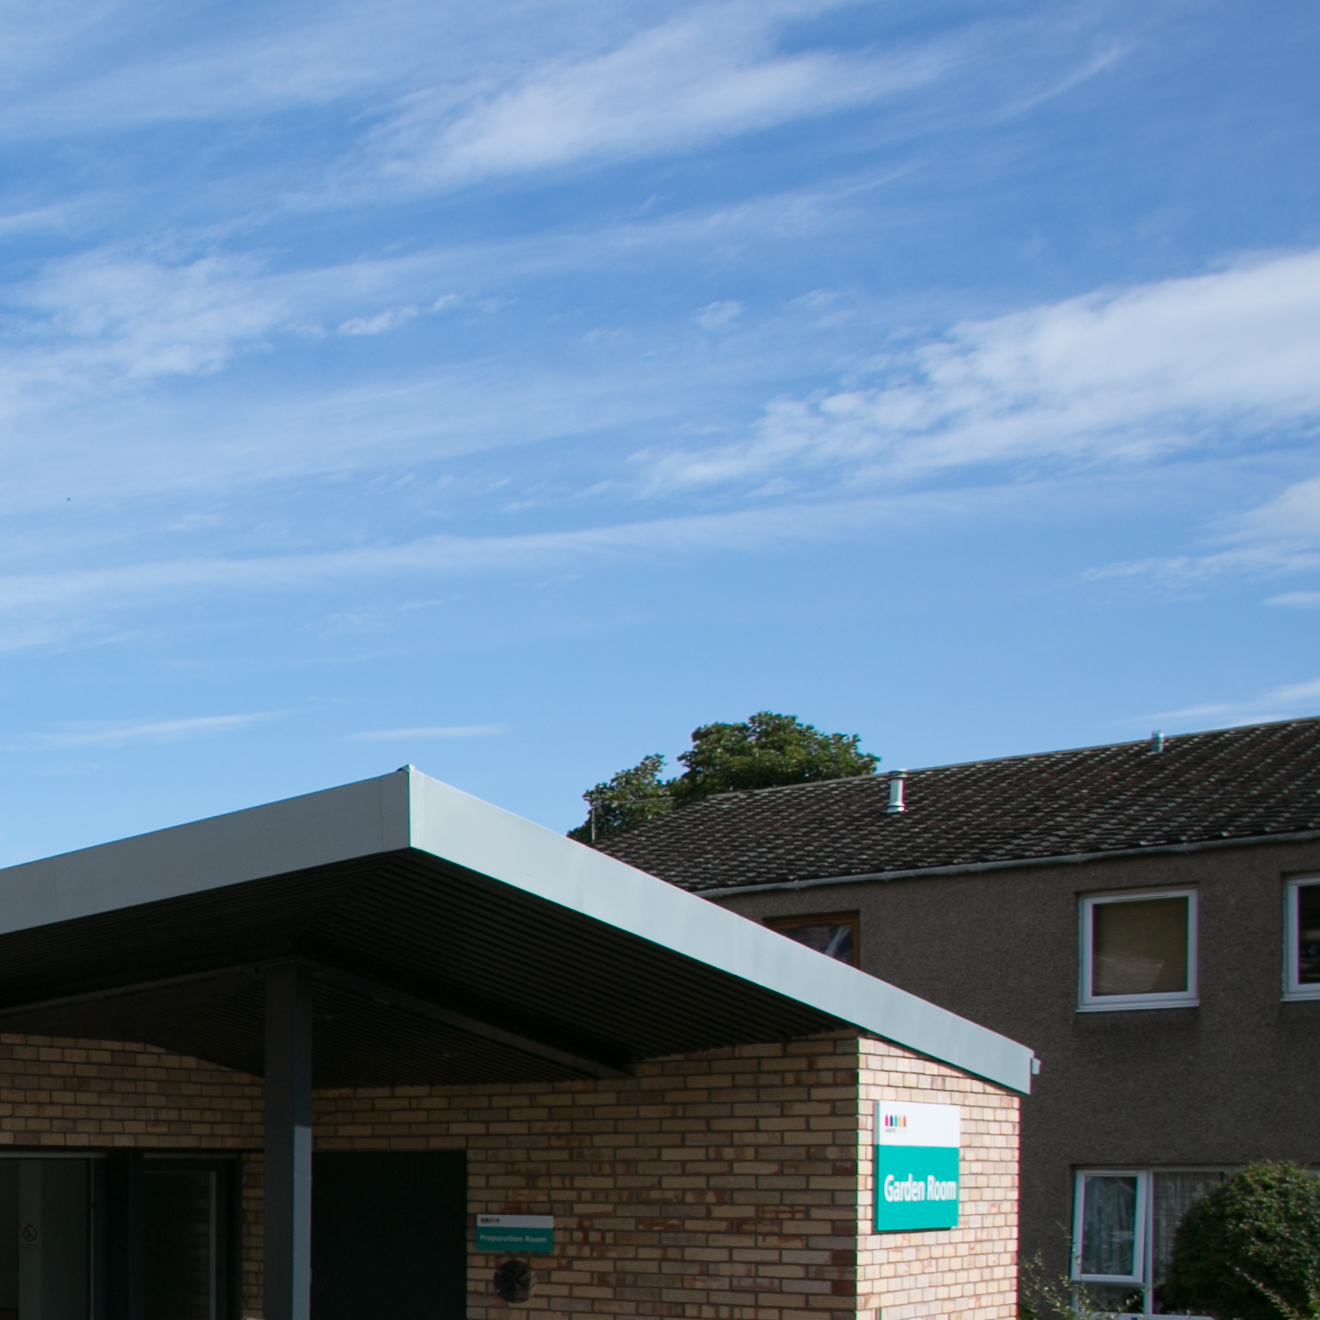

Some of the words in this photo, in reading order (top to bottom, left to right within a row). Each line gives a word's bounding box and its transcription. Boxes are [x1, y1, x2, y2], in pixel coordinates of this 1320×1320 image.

[884, 1173, 926, 1203] Garden
[927, 1174, 957, 1202] Room
[480, 1234, 523, 1242] Preparation
[525, 1235, 547, 1243] Room
